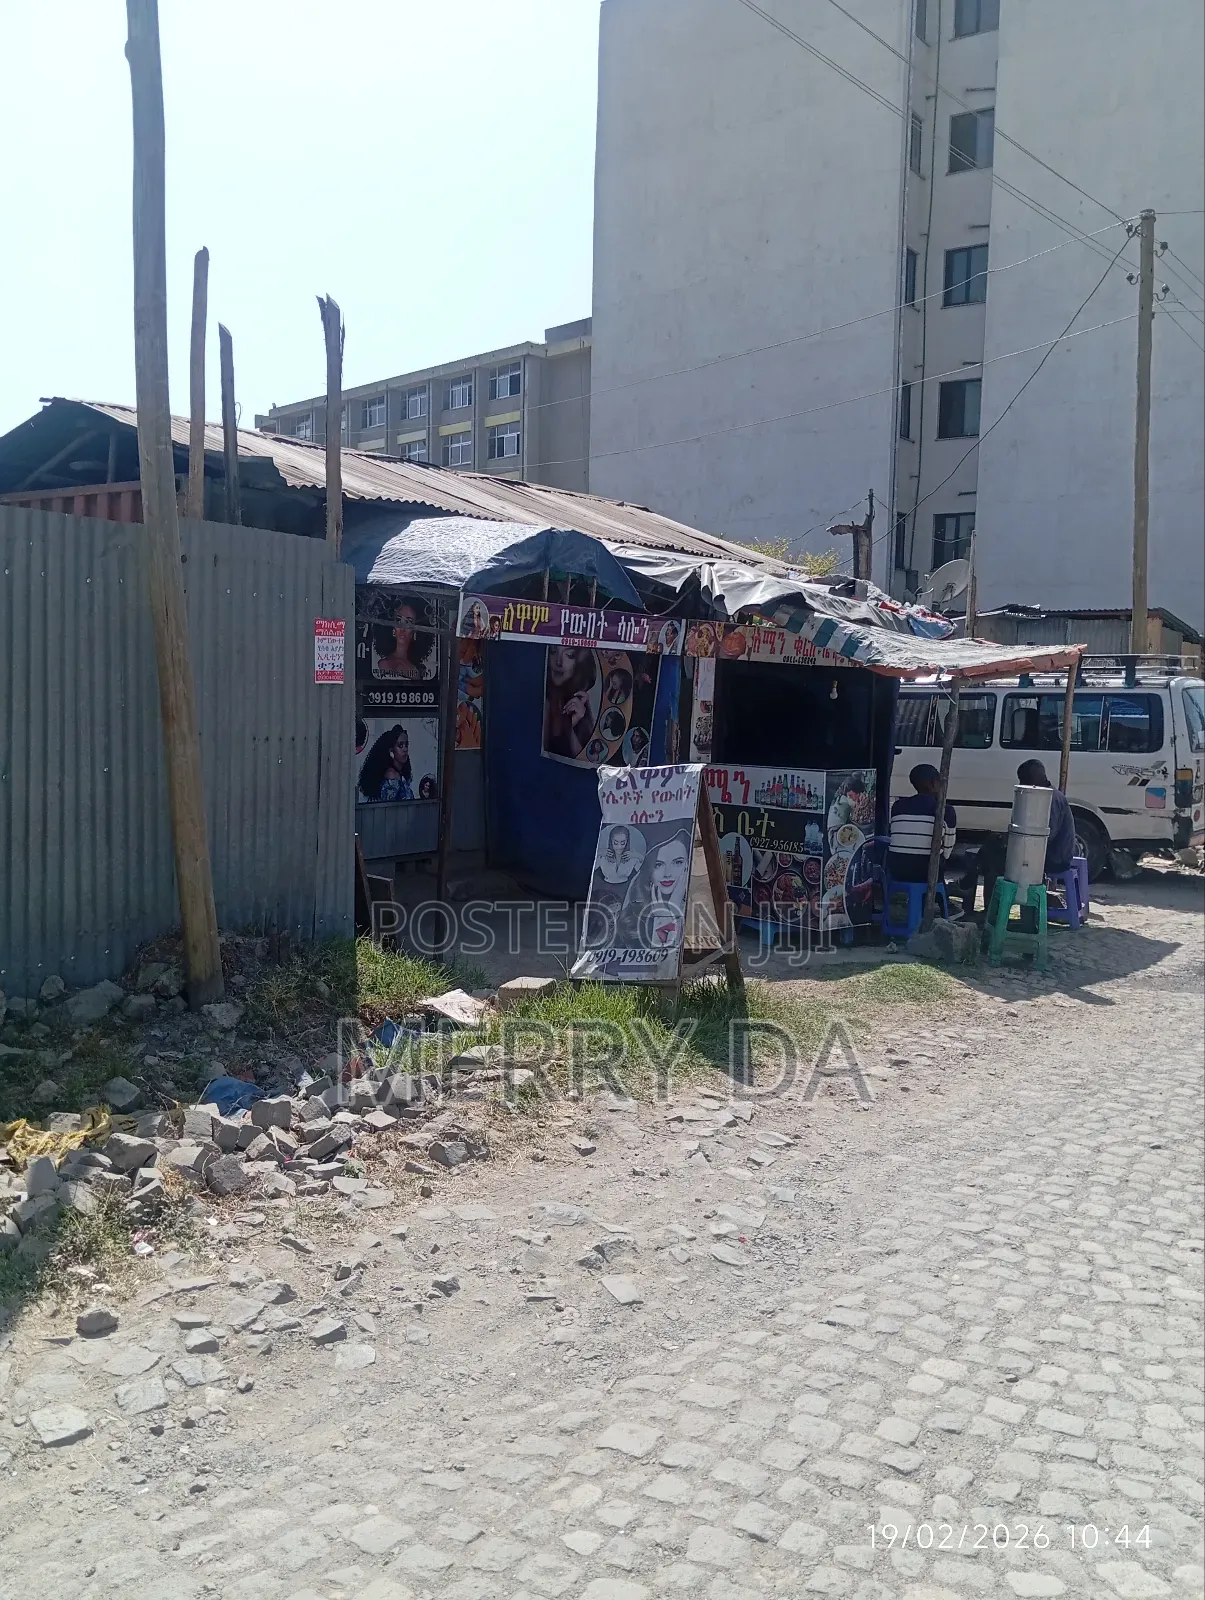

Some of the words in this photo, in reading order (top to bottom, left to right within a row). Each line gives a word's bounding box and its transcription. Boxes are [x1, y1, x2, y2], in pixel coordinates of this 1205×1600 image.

[560, 608, 608, 640] የውበት
[618, 615, 650, 643] ሳሎን
[737, 808, 776, 838] ቤት
[749, 836, 805, 854] 0927-956185
[587, 949, 669, 963] 0919-198609
